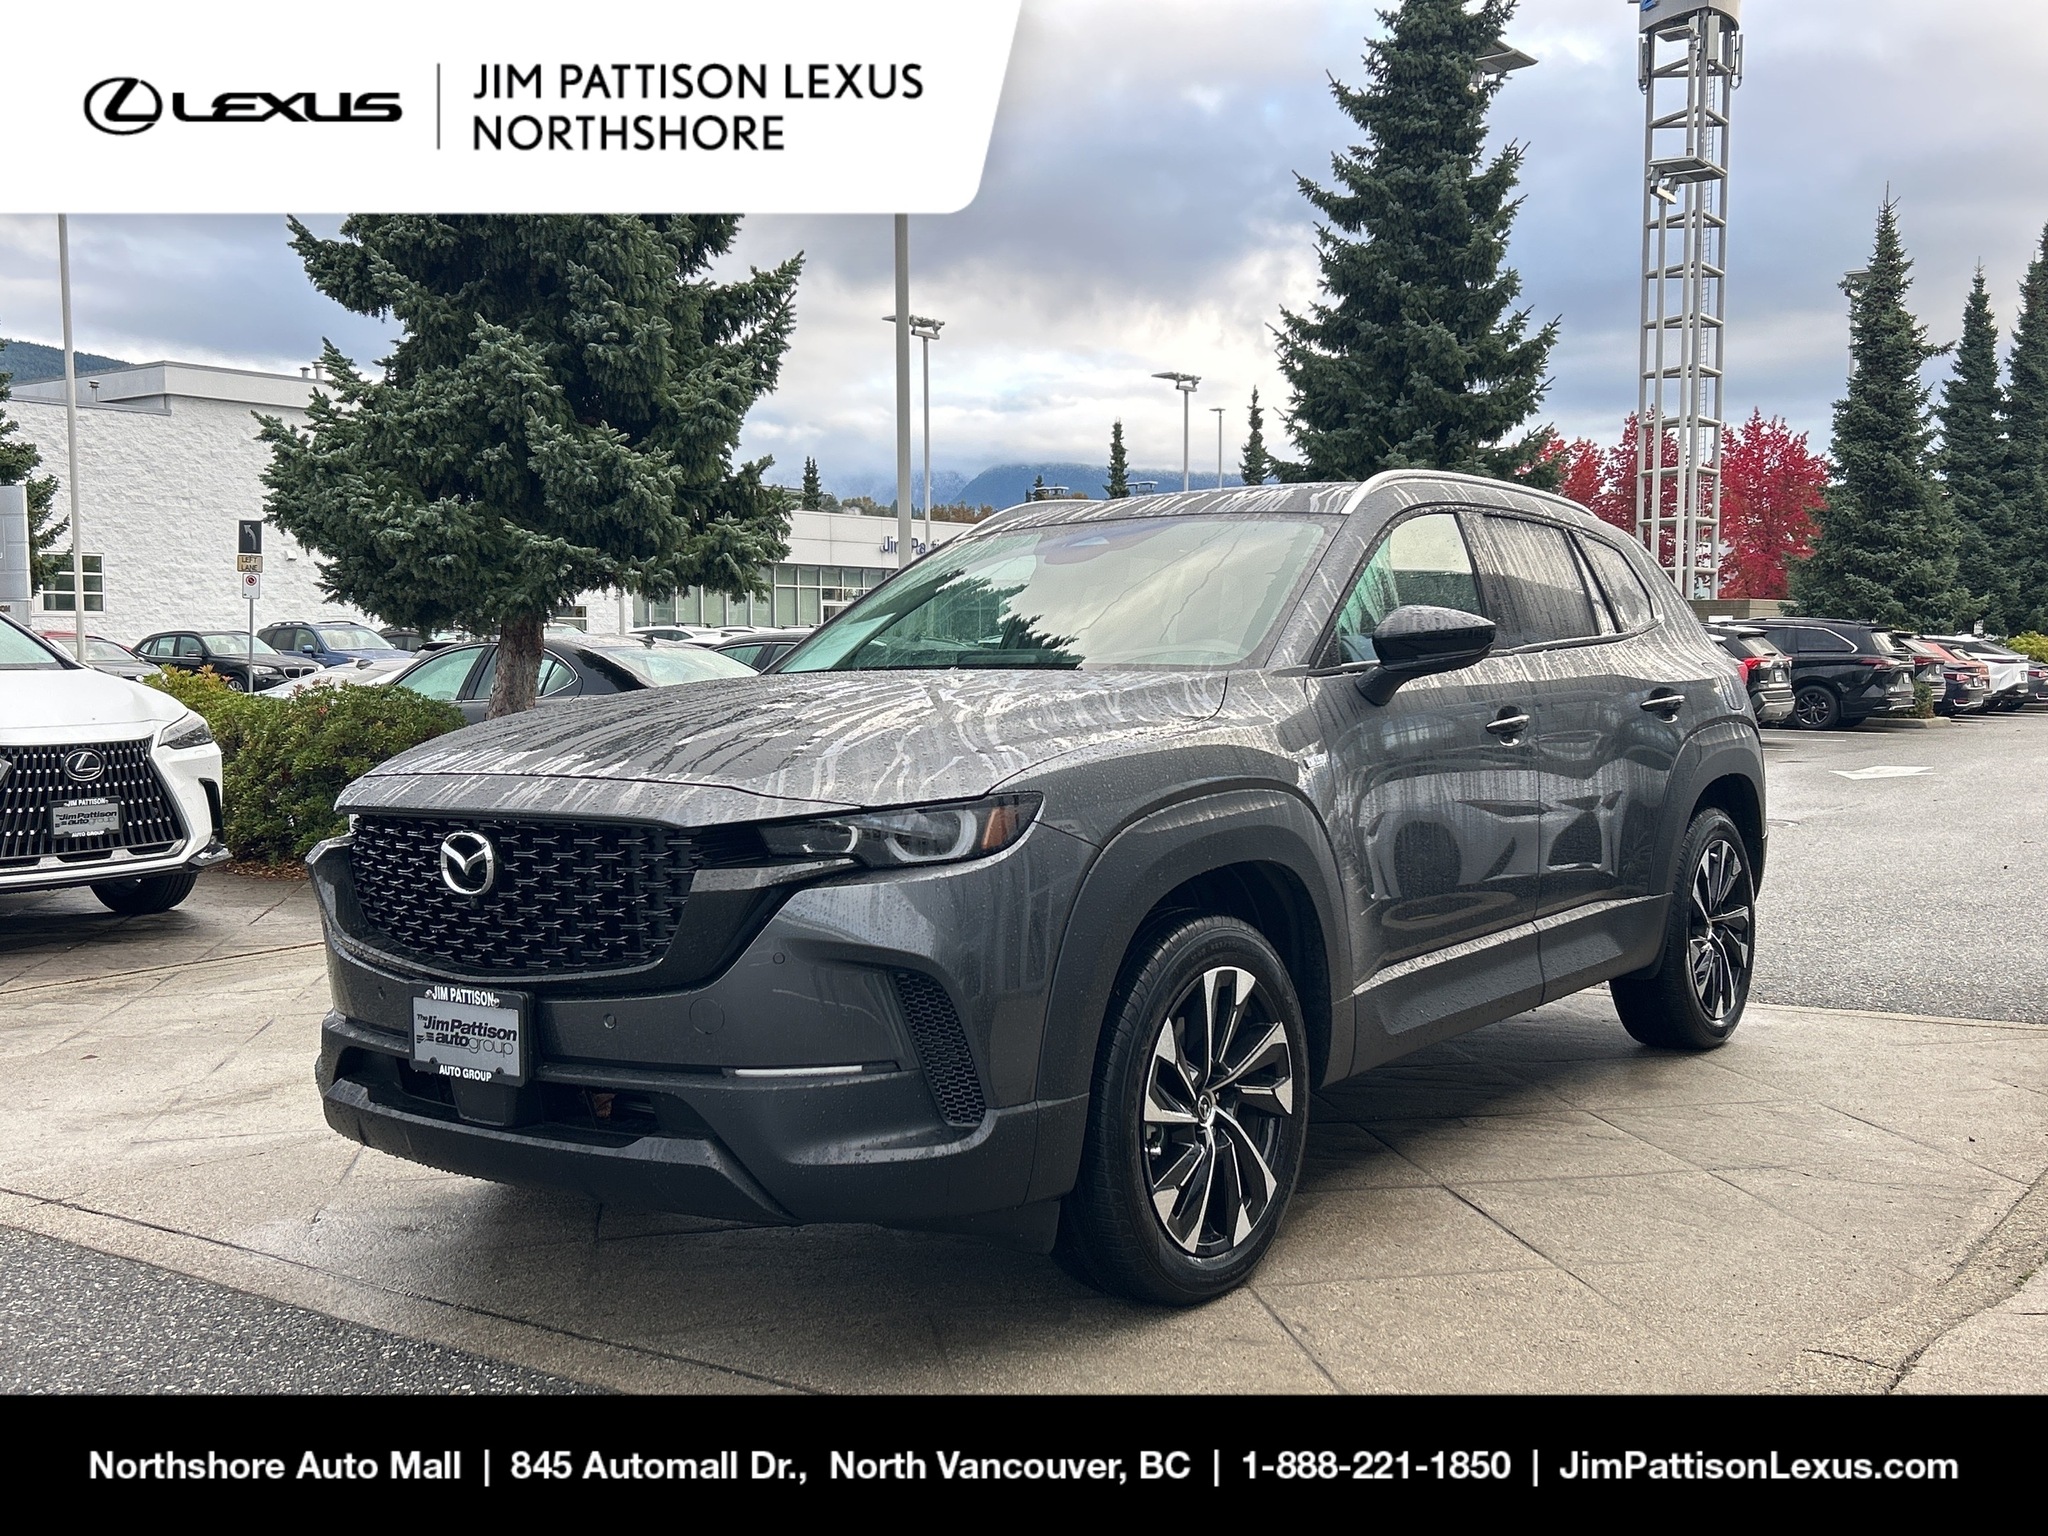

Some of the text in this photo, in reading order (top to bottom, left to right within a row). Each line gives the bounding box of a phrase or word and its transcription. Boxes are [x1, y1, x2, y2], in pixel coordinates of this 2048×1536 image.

[78, 798, 106, 806] PATTISON
[432, 985, 496, 1007] JIM PATTISON
[417, 1013, 428, 1022] The
[438, 1064, 493, 1082] AUTO GROUP
